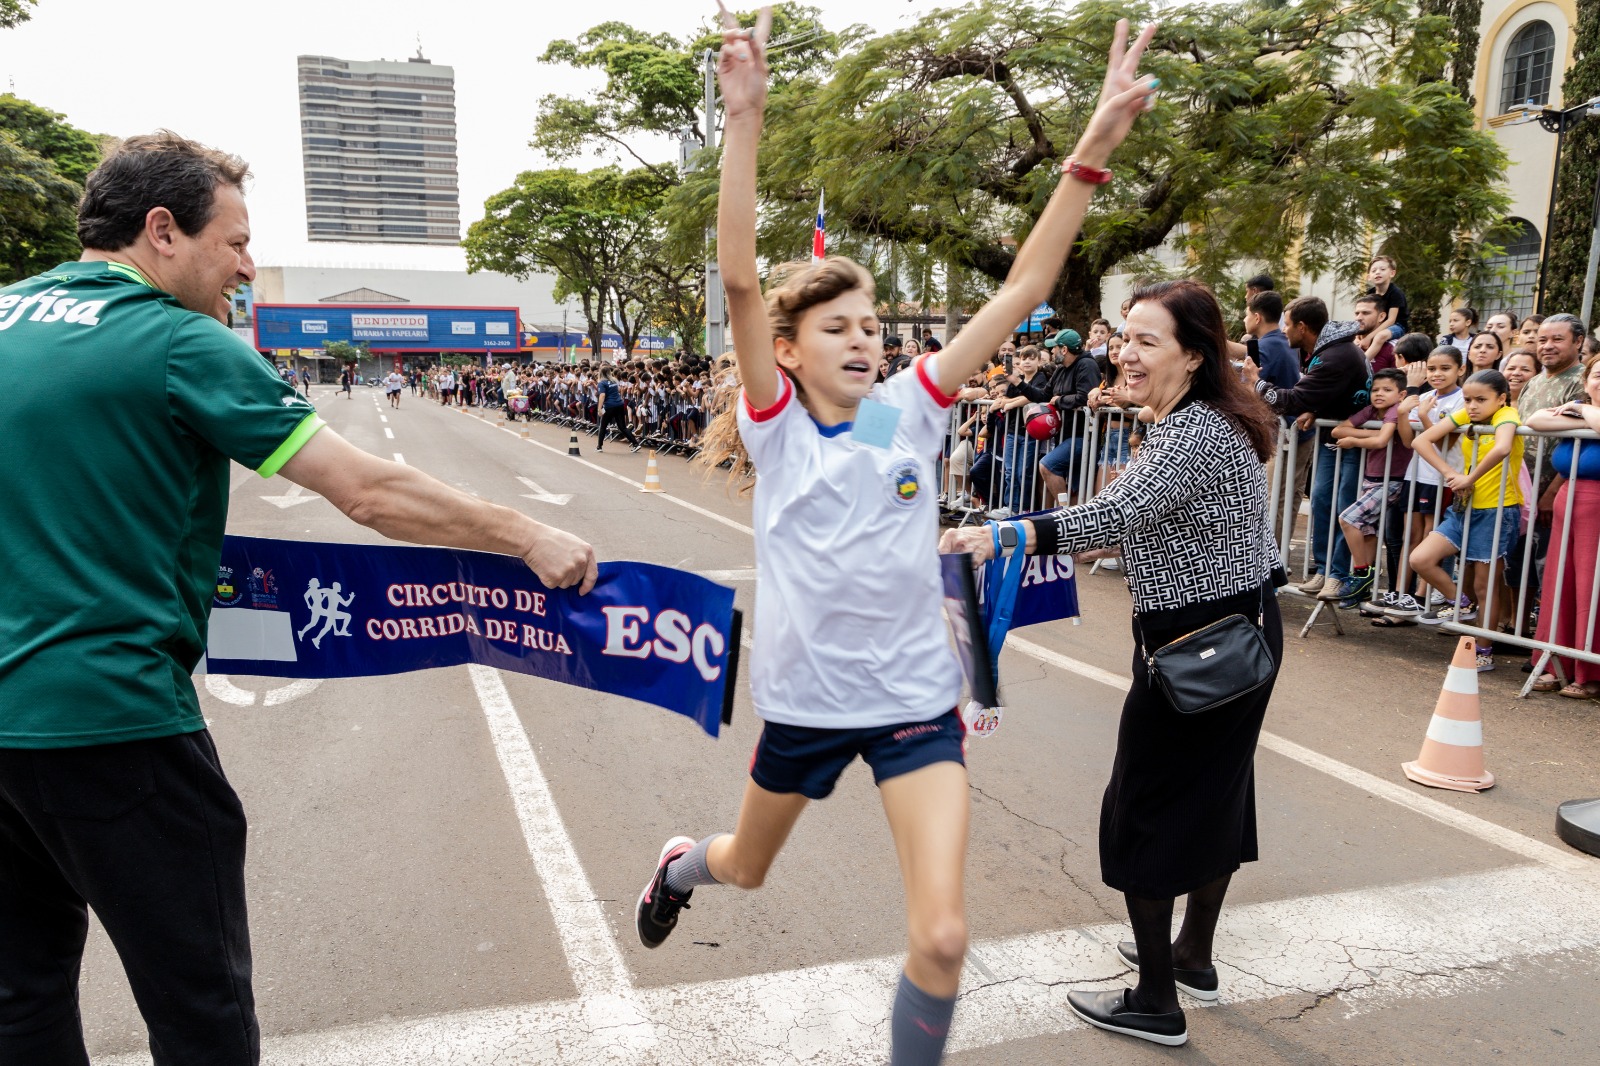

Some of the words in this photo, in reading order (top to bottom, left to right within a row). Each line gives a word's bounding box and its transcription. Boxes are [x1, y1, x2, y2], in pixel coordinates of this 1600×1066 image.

[0, 286, 108, 331] efisa
[354, 317, 425, 326] TENDTUDO
[387, 582, 509, 609] CIRCUITO
[514, 588, 547, 615] DE
[366, 612, 482, 641] CORRIDA
[484, 618, 519, 643] DE
[523, 627, 573, 655] RUA
[601, 605, 725, 682] ESC
